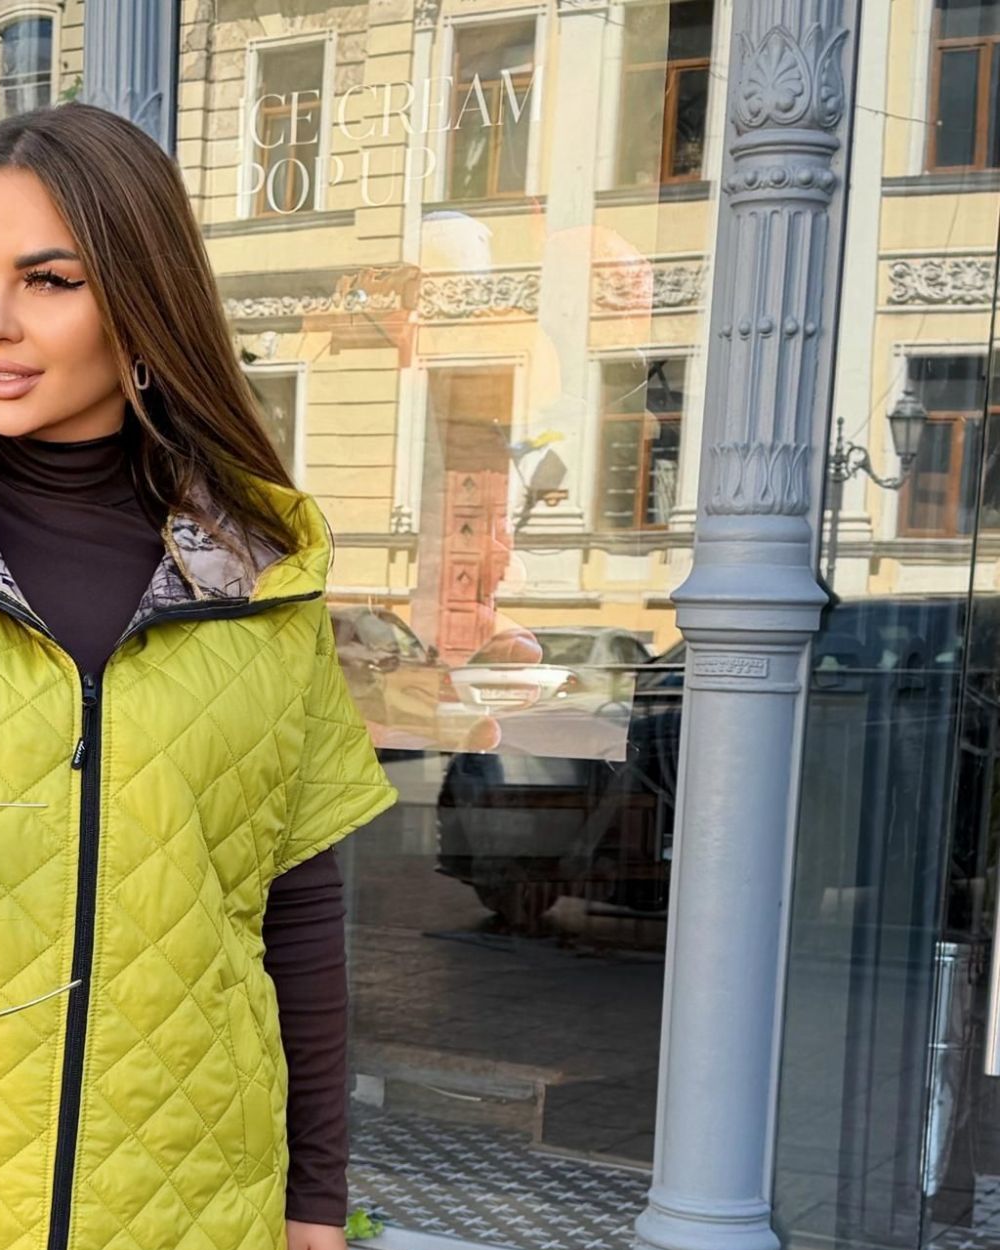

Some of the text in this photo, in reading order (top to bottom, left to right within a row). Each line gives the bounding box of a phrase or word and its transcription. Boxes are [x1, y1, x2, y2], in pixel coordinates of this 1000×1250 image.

[238, 65, 544, 150] ICE CREAM
[236, 146, 437, 218] POP UP
